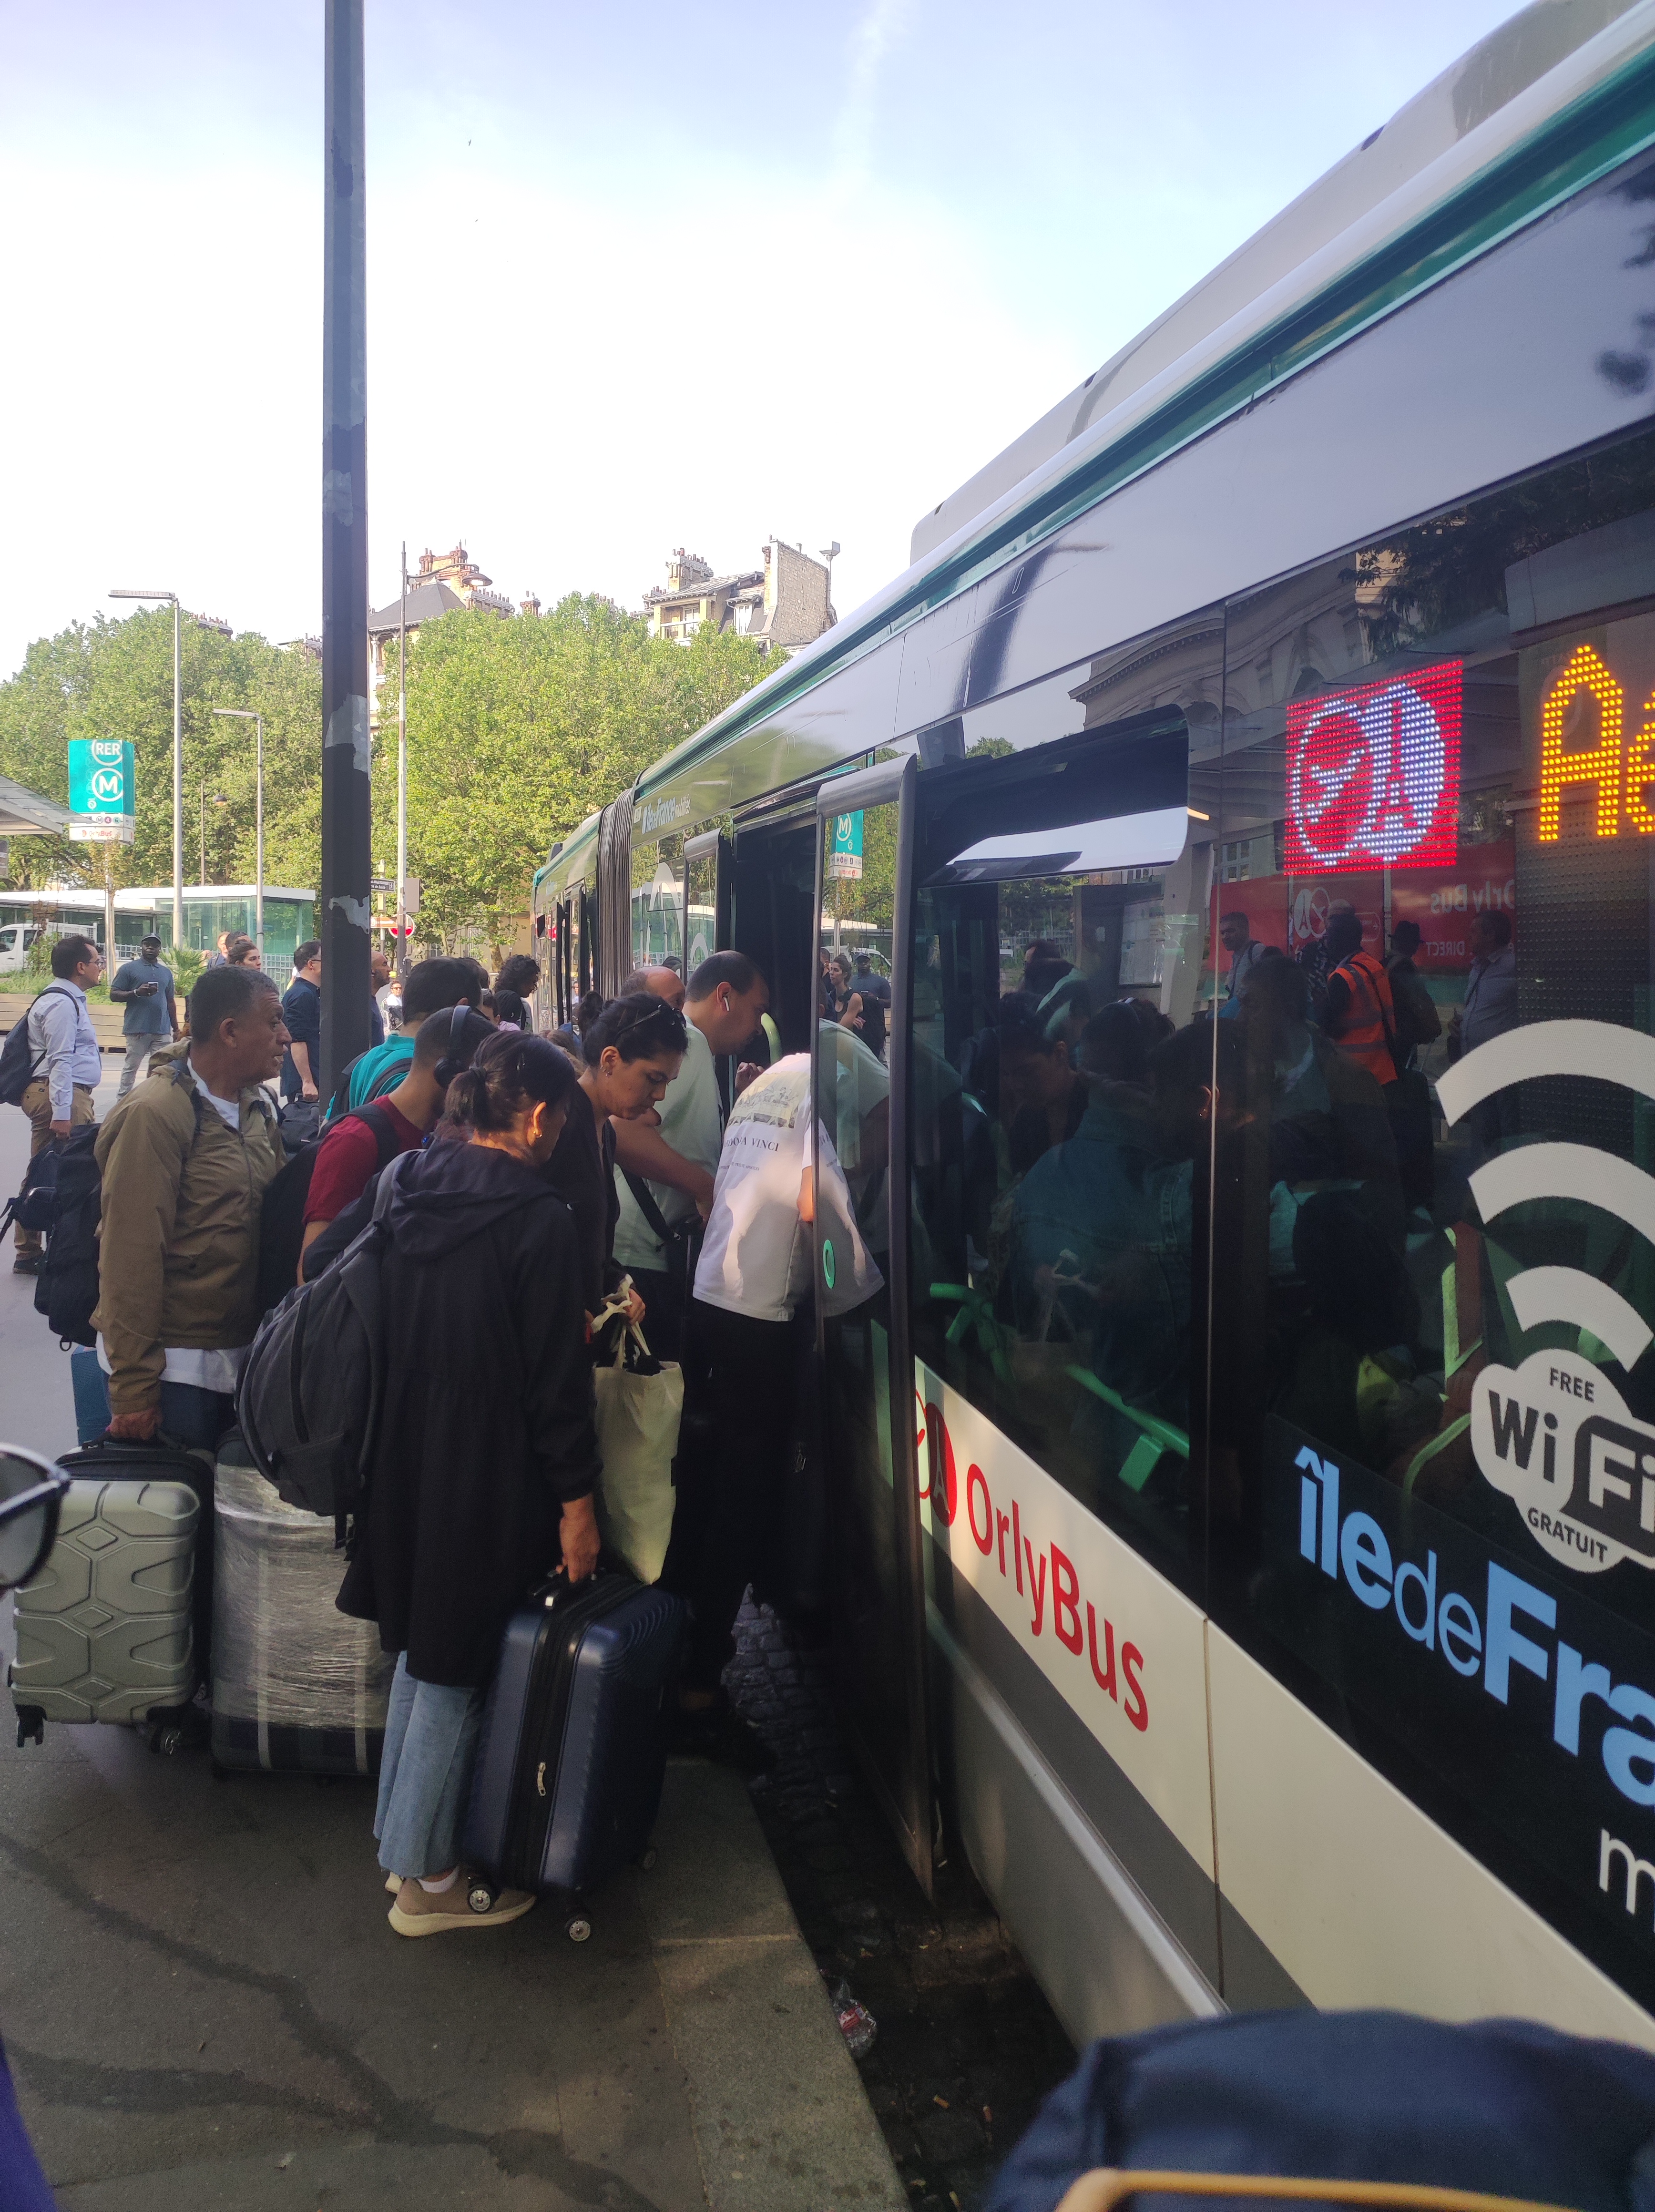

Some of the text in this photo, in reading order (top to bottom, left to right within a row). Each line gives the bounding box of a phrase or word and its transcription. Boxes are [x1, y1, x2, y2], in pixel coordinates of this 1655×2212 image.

[96, 743, 121, 755] RER
[99, 775, 118, 794] M
[752, 1137, 779, 1152] VINCI
[1549, 1366, 1595, 1403] FREE
[1527, 1506, 1608, 1564] GRATUIT
[966, 1463, 1149, 1732] OrlyBus
